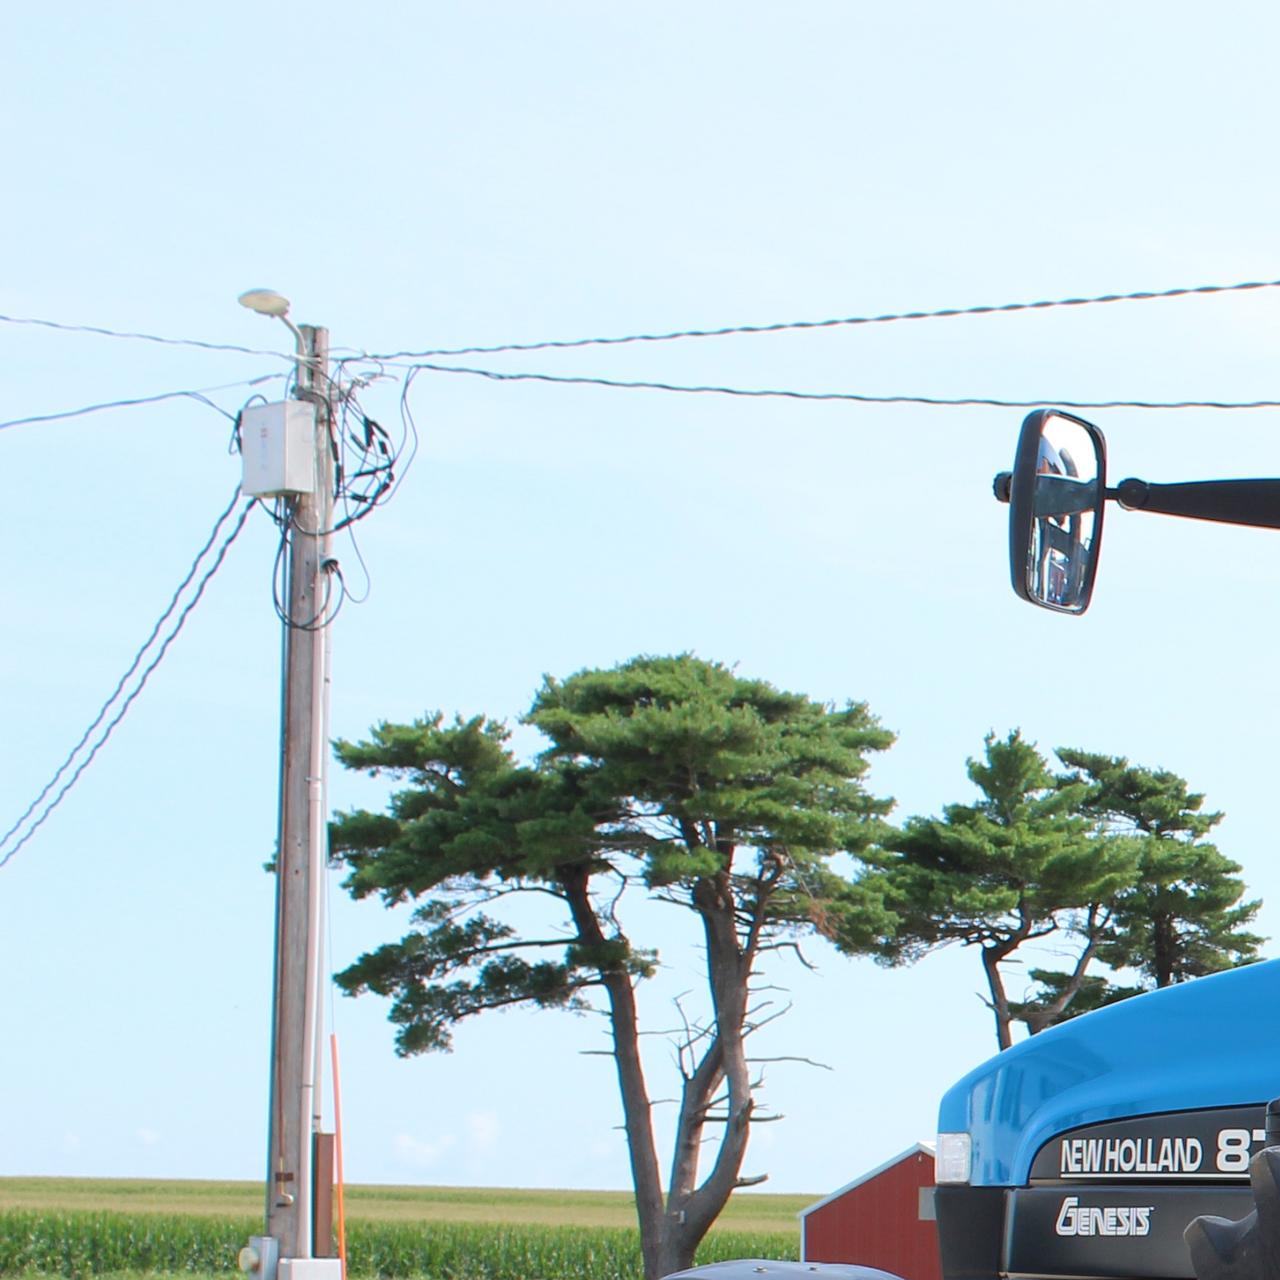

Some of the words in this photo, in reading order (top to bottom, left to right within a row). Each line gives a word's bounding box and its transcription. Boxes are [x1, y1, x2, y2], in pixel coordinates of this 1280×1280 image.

[1060, 1138, 1103, 1173] NEW
[1104, 1137, 1203, 1172] HOLLAND
[1215, 1128, 1266, 1172] 8
